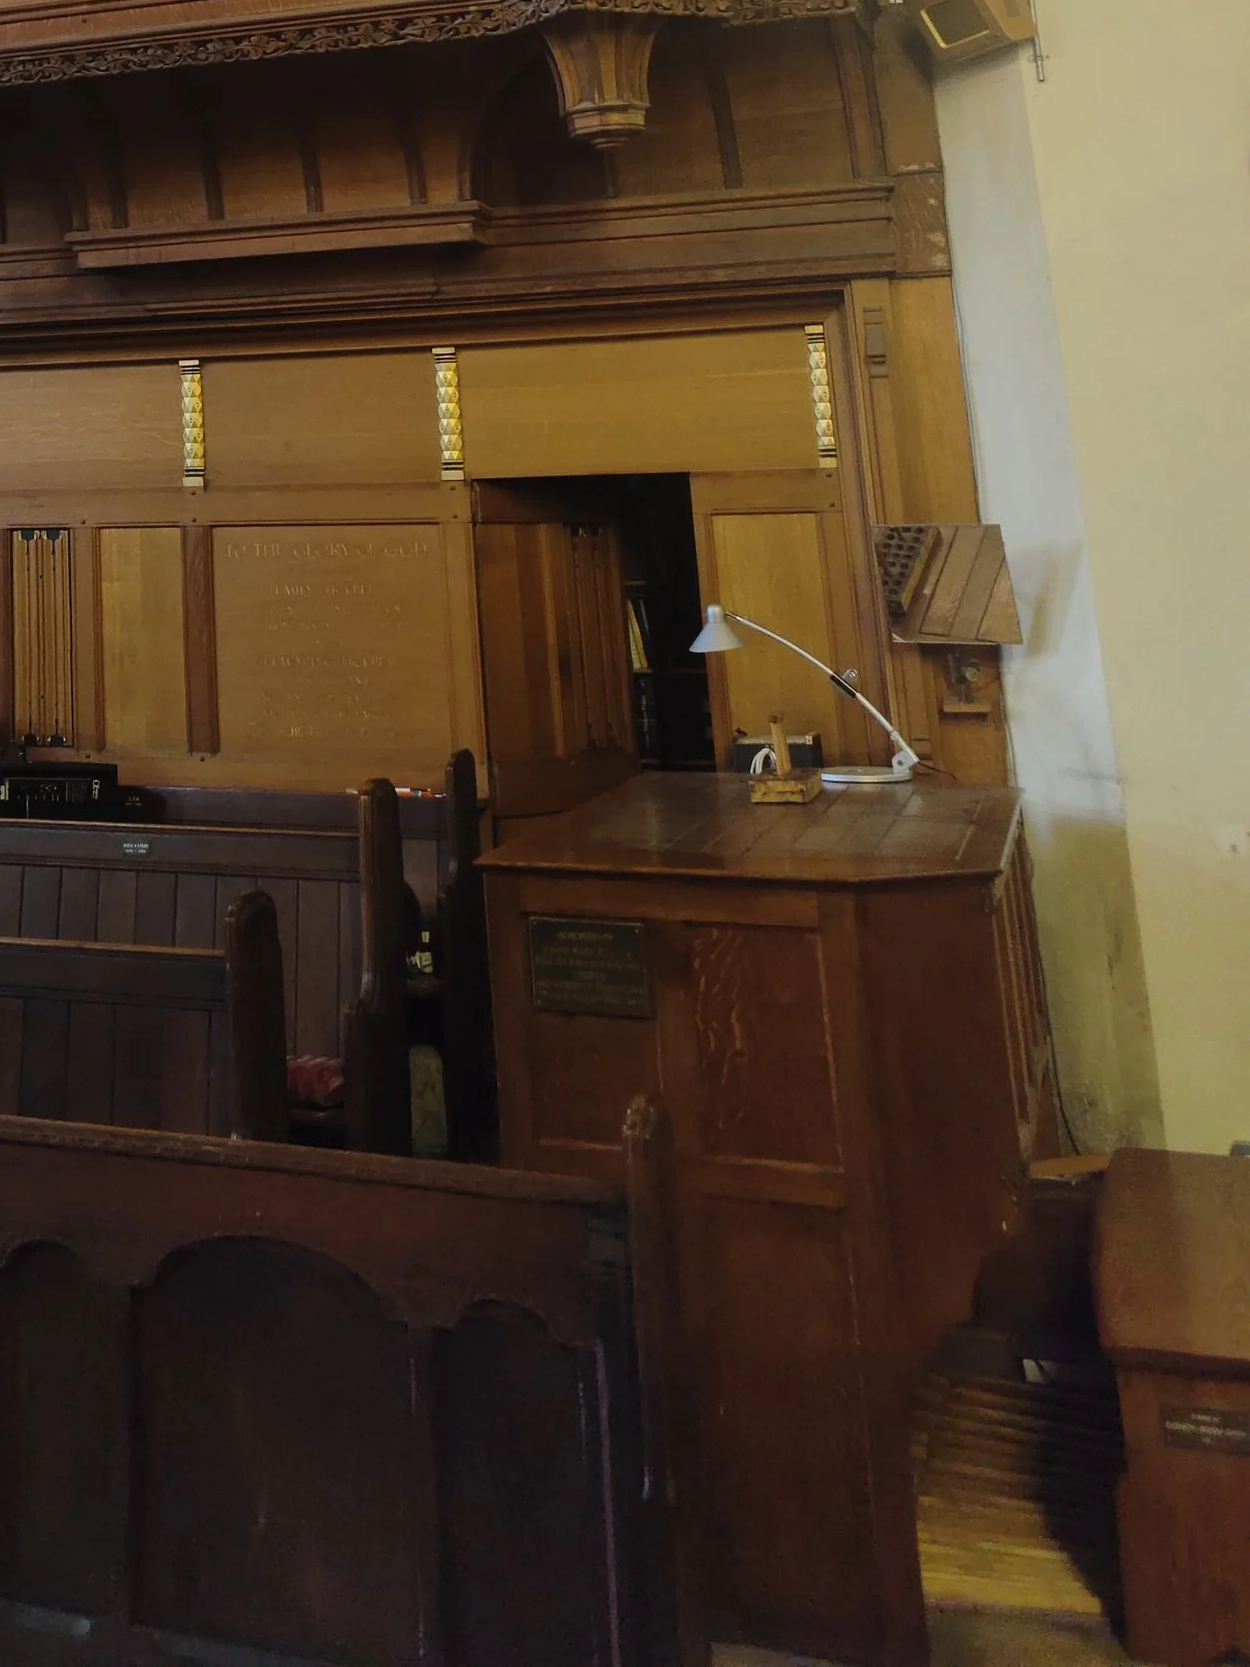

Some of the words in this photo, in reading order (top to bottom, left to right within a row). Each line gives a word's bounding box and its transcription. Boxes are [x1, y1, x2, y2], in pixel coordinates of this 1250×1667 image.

[253, 542, 282, 558] THE
[292, 542, 350, 559] GLORY
[383, 541, 428, 558] GOD
